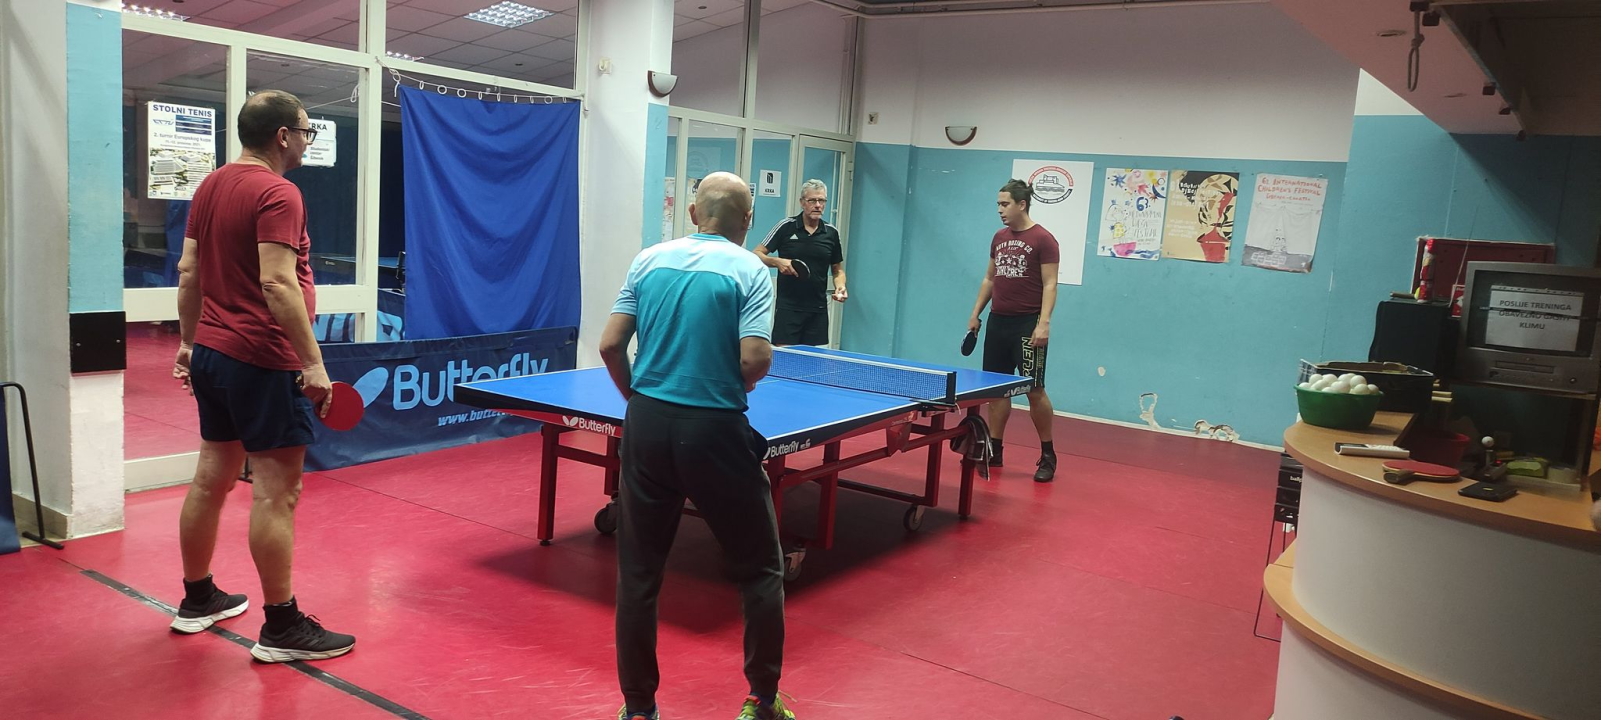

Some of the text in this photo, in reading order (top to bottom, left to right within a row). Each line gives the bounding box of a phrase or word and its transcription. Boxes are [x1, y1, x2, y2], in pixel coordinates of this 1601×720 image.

[152, 104, 213, 118] STOLNI TENIS
[308, 122, 328, 131] RKA
[1272, 179, 1322, 189] INTERNATIONAL
[1294, 187, 1321, 196] FESTIVAL
[1499, 300, 1572, 311] POSLIJE TRENINGA
[1519, 322, 1546, 330] KLIMU
[578, 417, 617, 436] Butterfly
[770, 440, 800, 458] Butterfly
